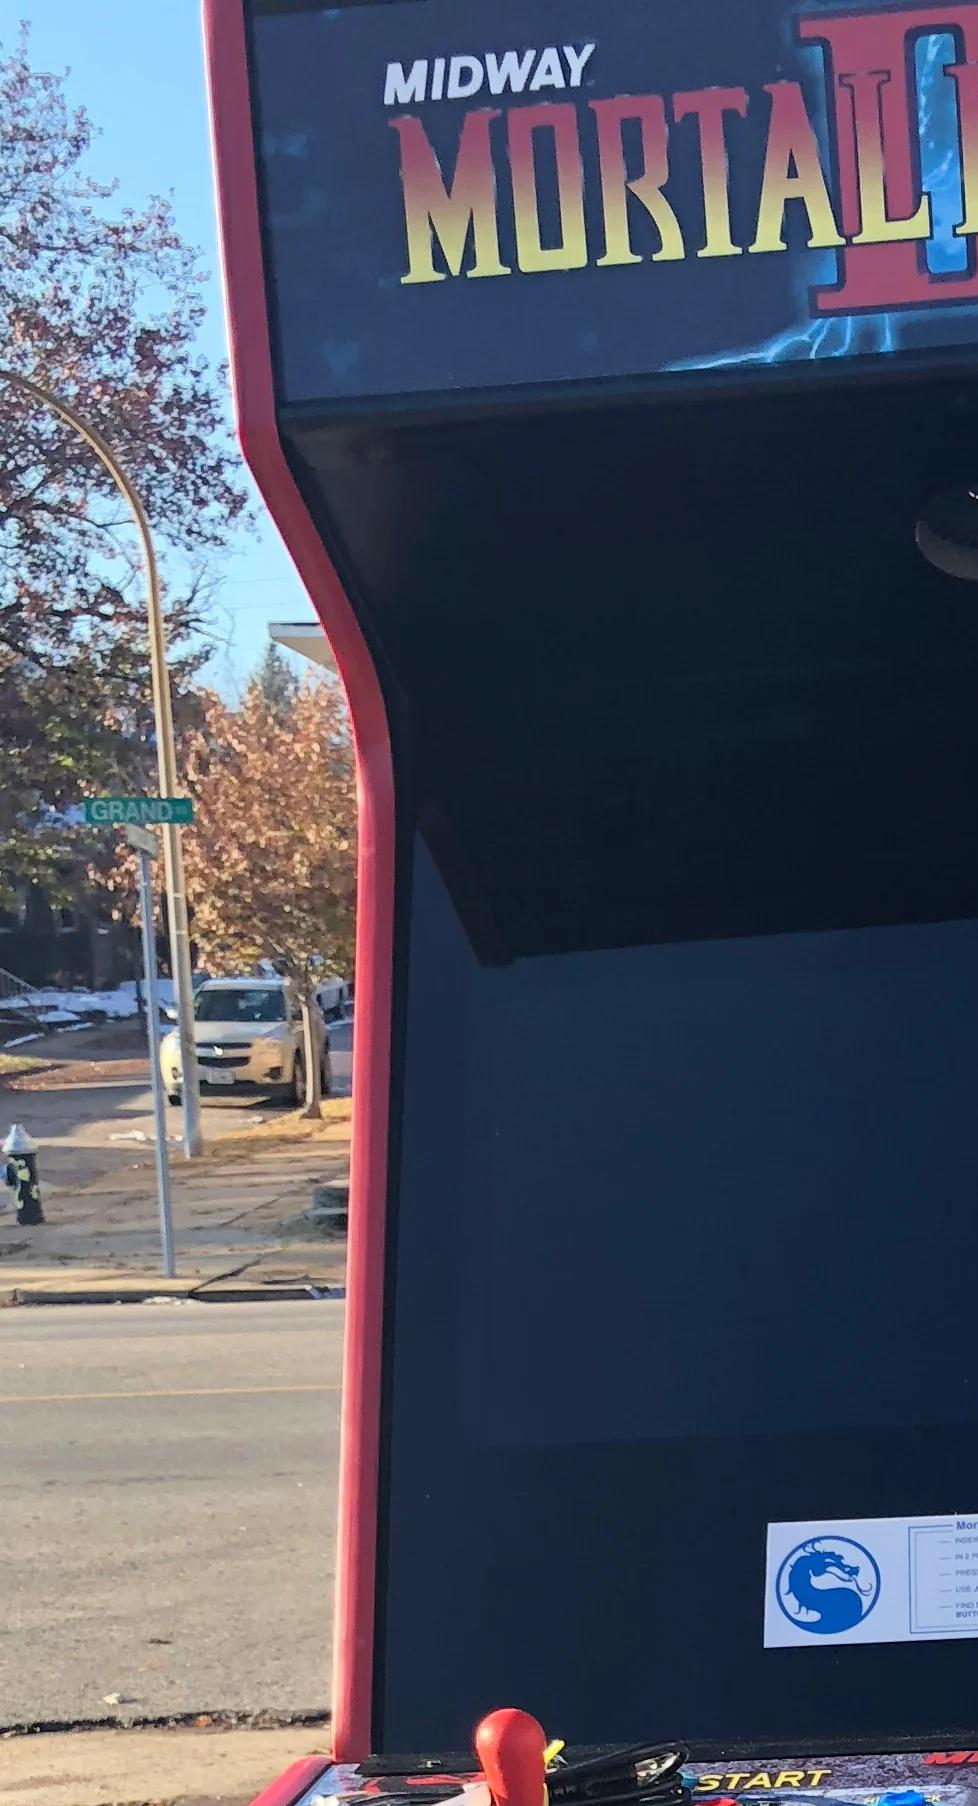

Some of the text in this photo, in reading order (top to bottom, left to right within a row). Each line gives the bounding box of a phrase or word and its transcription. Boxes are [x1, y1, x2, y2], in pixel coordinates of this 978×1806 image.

[383, 43, 596, 106] MIDWAY
[388, 70, 932, 285] MORTAL
[90, 800, 173, 821] GRAND
[955, 1585, 972, 1593] USE
[694, 1769, 832, 1792] START
